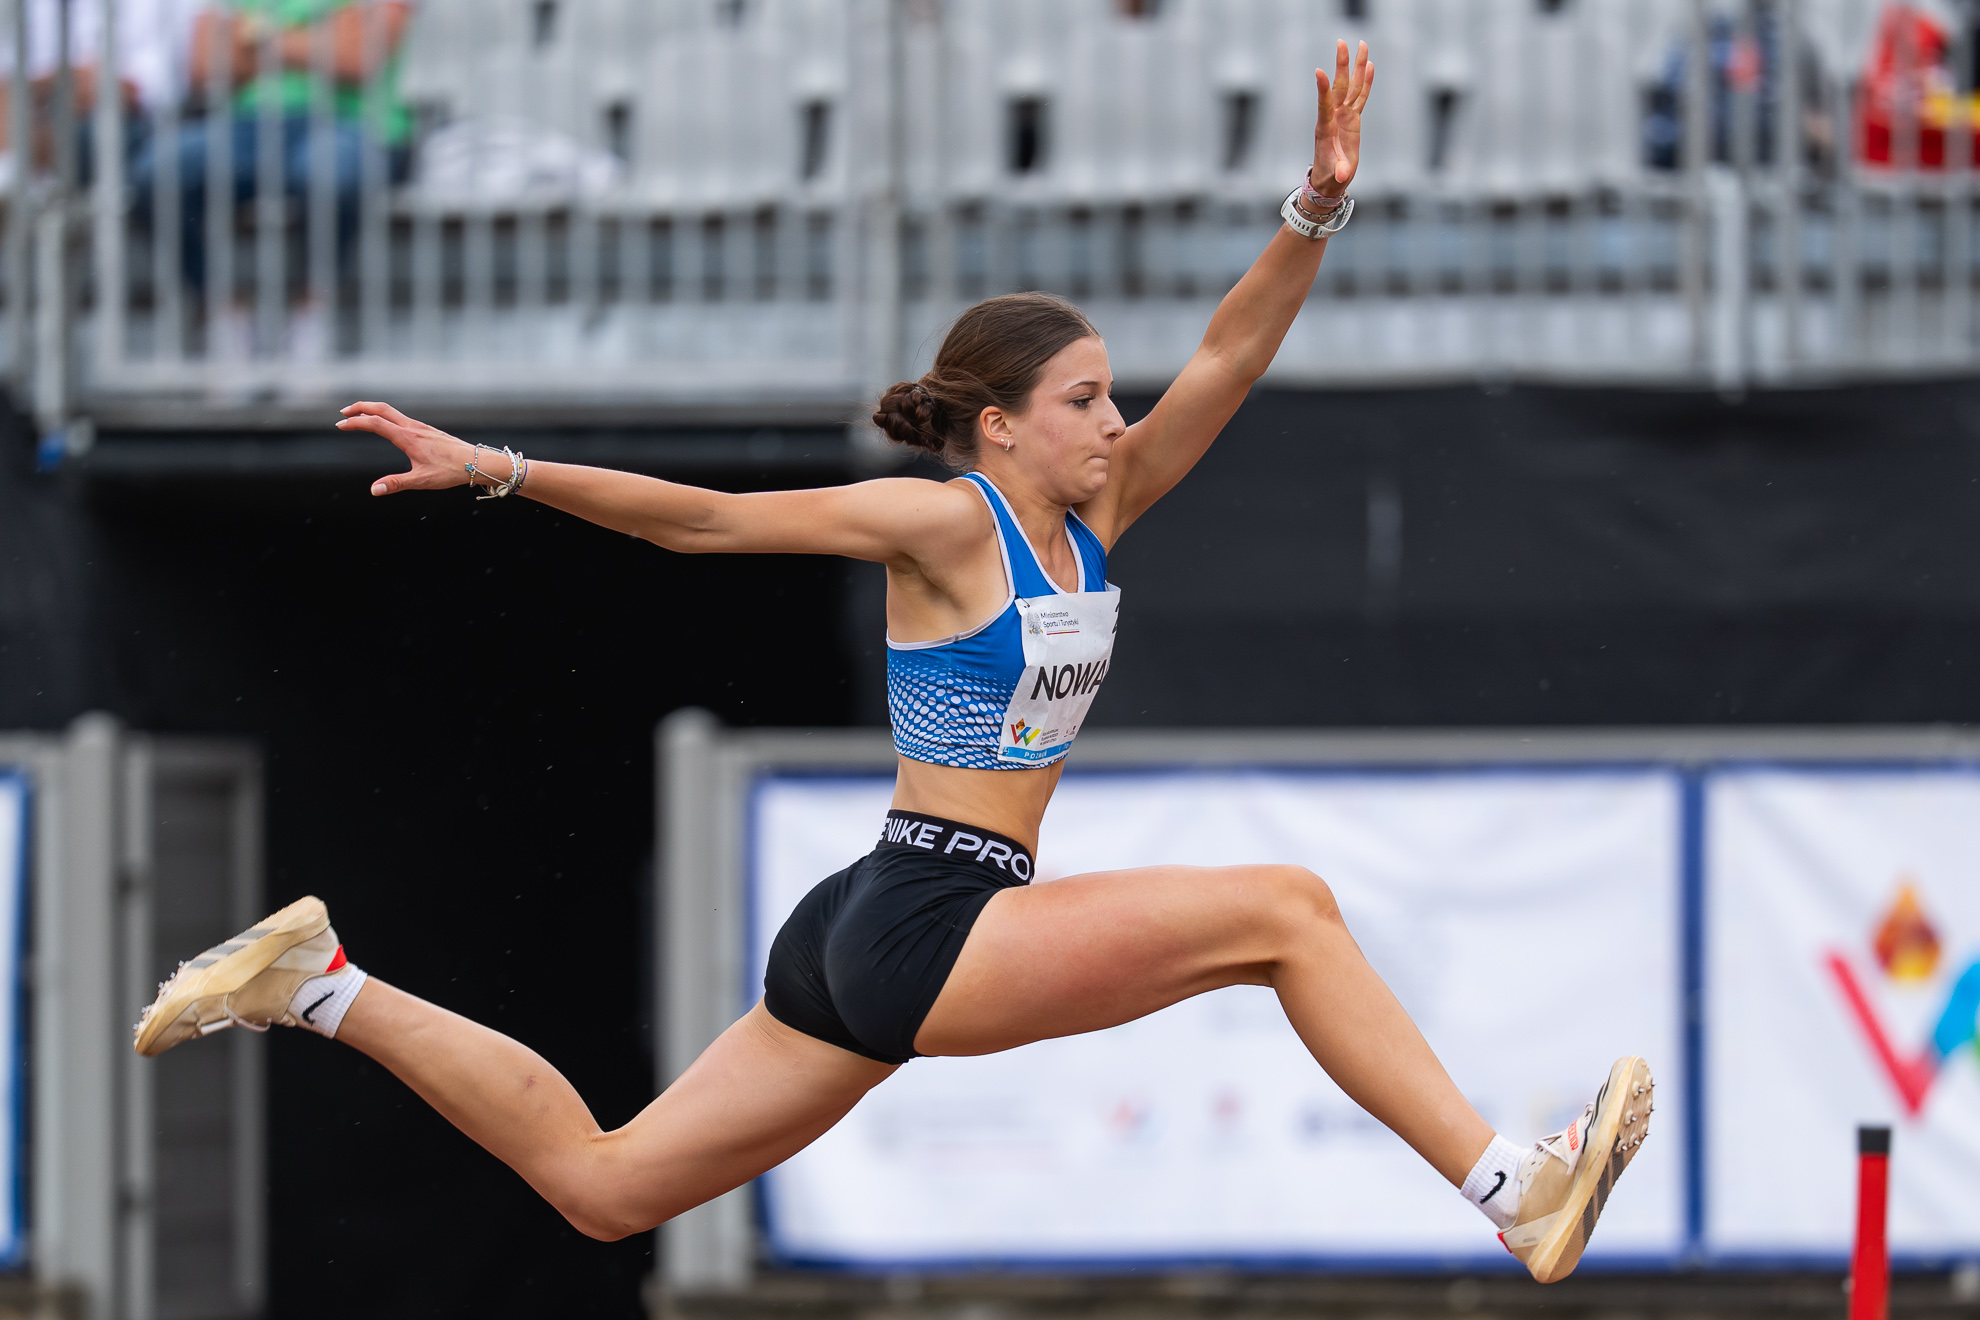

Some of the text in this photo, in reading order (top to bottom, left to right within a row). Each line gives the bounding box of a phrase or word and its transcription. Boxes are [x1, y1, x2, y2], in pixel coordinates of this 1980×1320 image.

[1030, 659, 1108, 702] NOWA
[884, 817, 944, 850] NIKE
[943, 830, 1031, 881] PRO
